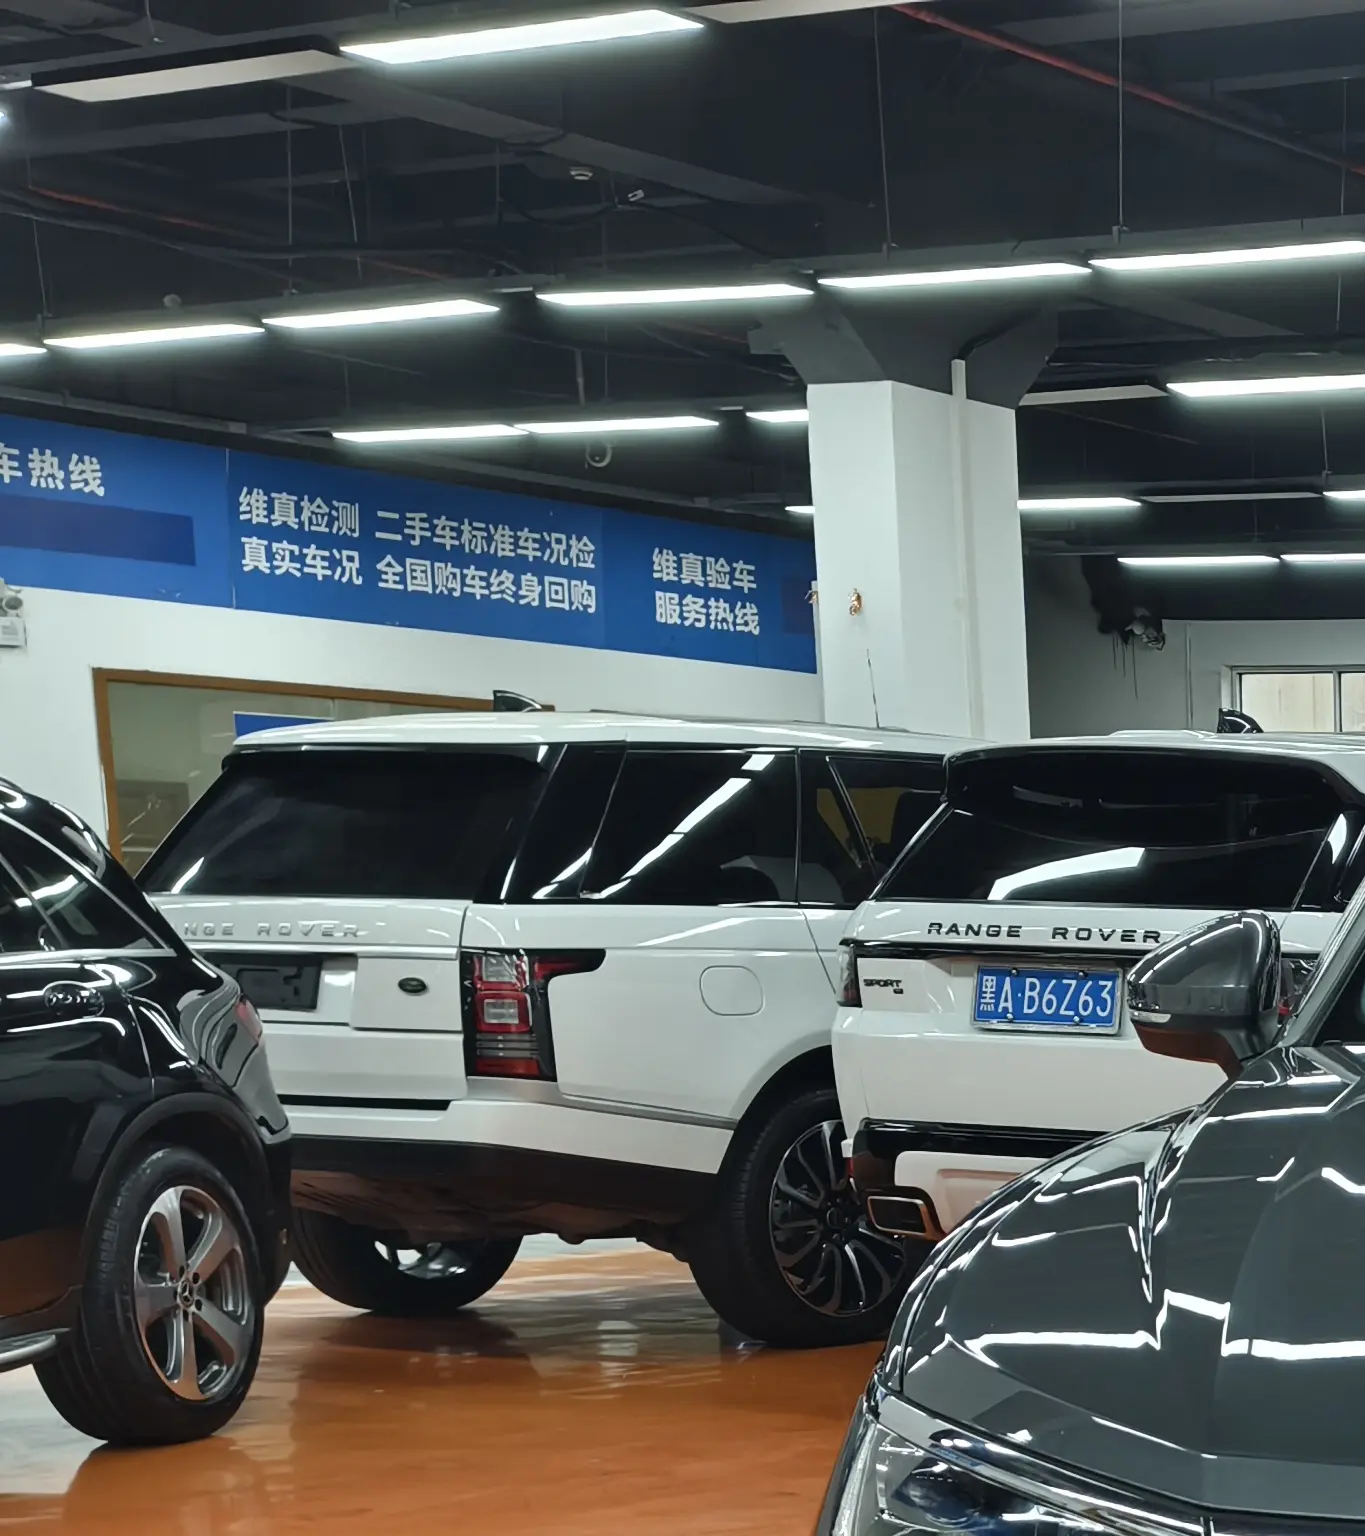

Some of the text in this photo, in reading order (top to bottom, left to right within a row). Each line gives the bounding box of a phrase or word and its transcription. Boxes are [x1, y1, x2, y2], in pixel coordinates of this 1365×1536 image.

[239, 486, 596, 569] 维真检测 二手车标准车况检
[241, 536, 597, 614] 真实车况 全国购车终身回购
[652, 547, 757, 594] 维真验车
[655, 590, 760, 636] 服务热线
[183, 922, 359, 938] NGE ROVER
[927, 922, 1161, 944] RANGE ROVER
